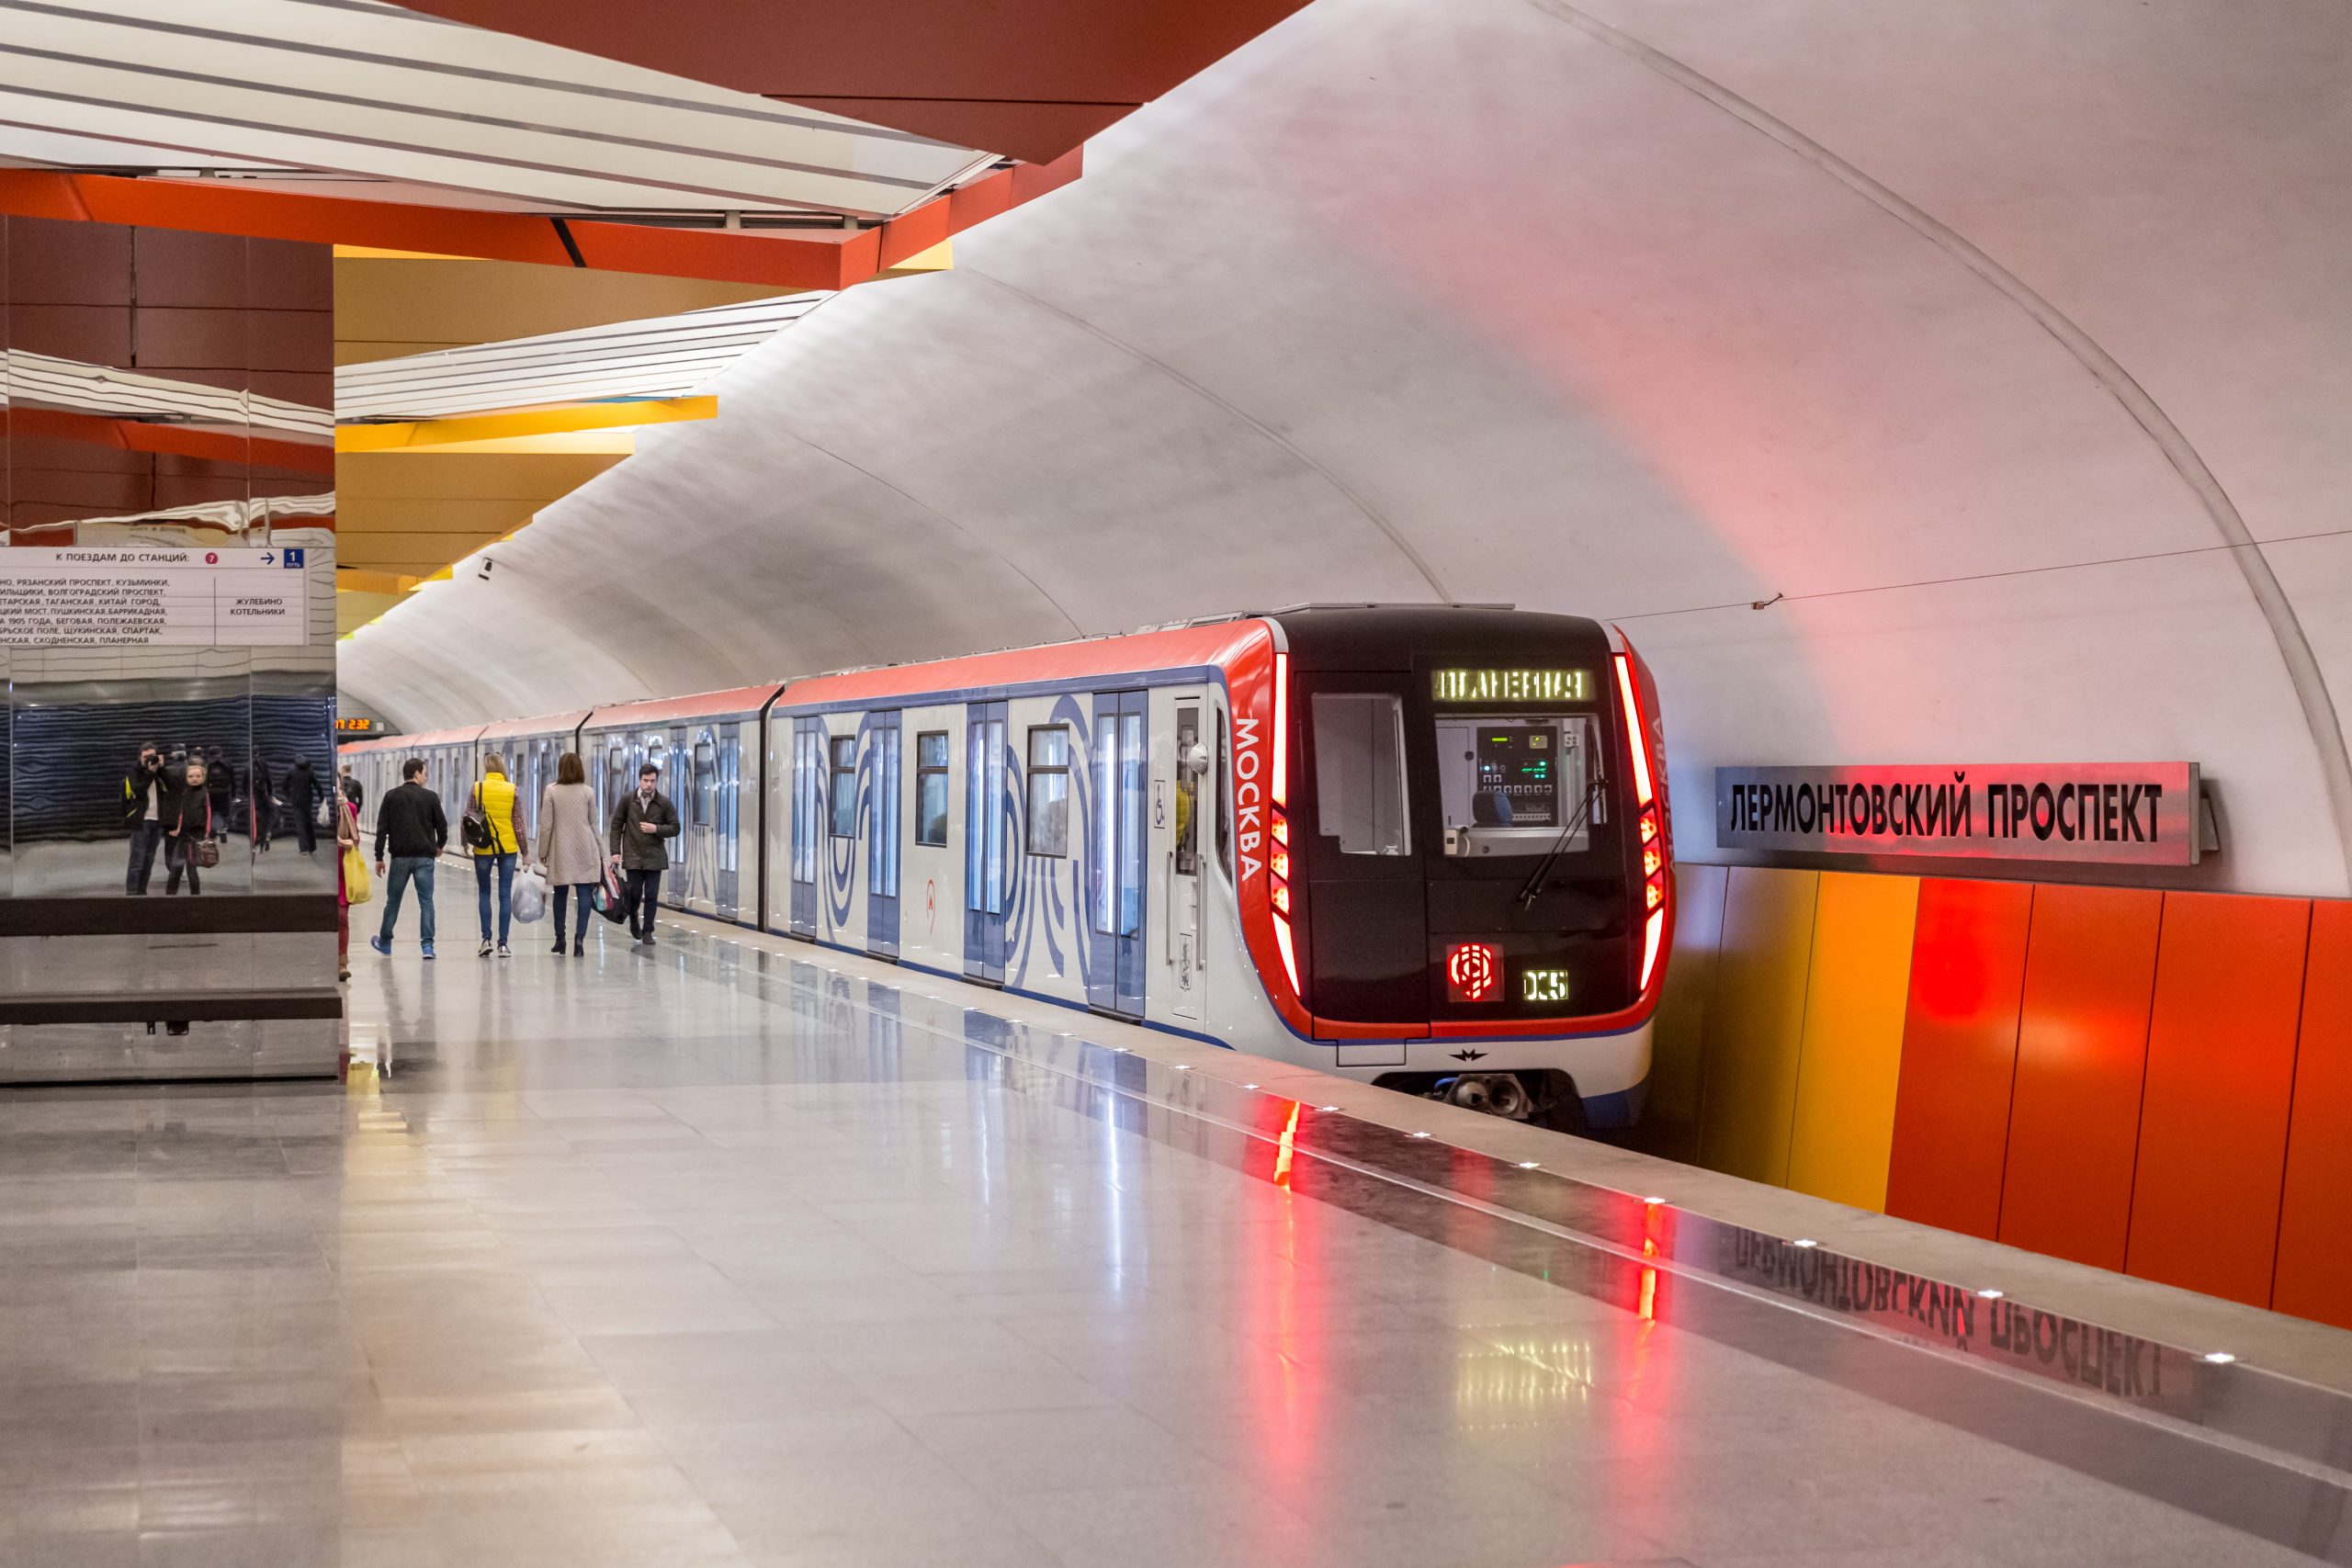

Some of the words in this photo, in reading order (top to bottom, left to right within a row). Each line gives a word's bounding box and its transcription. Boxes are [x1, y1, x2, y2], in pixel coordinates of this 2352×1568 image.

[56, 553, 63, 561] К
[66, 553, 117, 562] ПОЕЗДАМ
[119, 553, 136, 562] ДО
[139, 552, 190, 562] СТАНЦИЙ:
[289, 551, 296, 562] 1
[17, 578, 67, 586] РЯЗАНСКИЙ
[116, 579, 170, 587] КУЗЬМИНКИ,
[48, 587, 119, 596] ВОЛГОГРАДСКИЙ
[121, 588, 166, 596] ПРОСПЕКТ,
[98, 597, 128, 605] КИТАЙ
[130, 598, 161, 607] ГОРОД,
[28, 617, 53, 626] ГОДА,
[121, 626, 163, 636] СПАРТАК,
[1236, 717, 1262, 882] МОСКВА
[1730, 771, 1973, 837] ЛЕРМОНТОВСКИЙ
[1987, 782, 2163, 843] ПРОСПЕКТ
